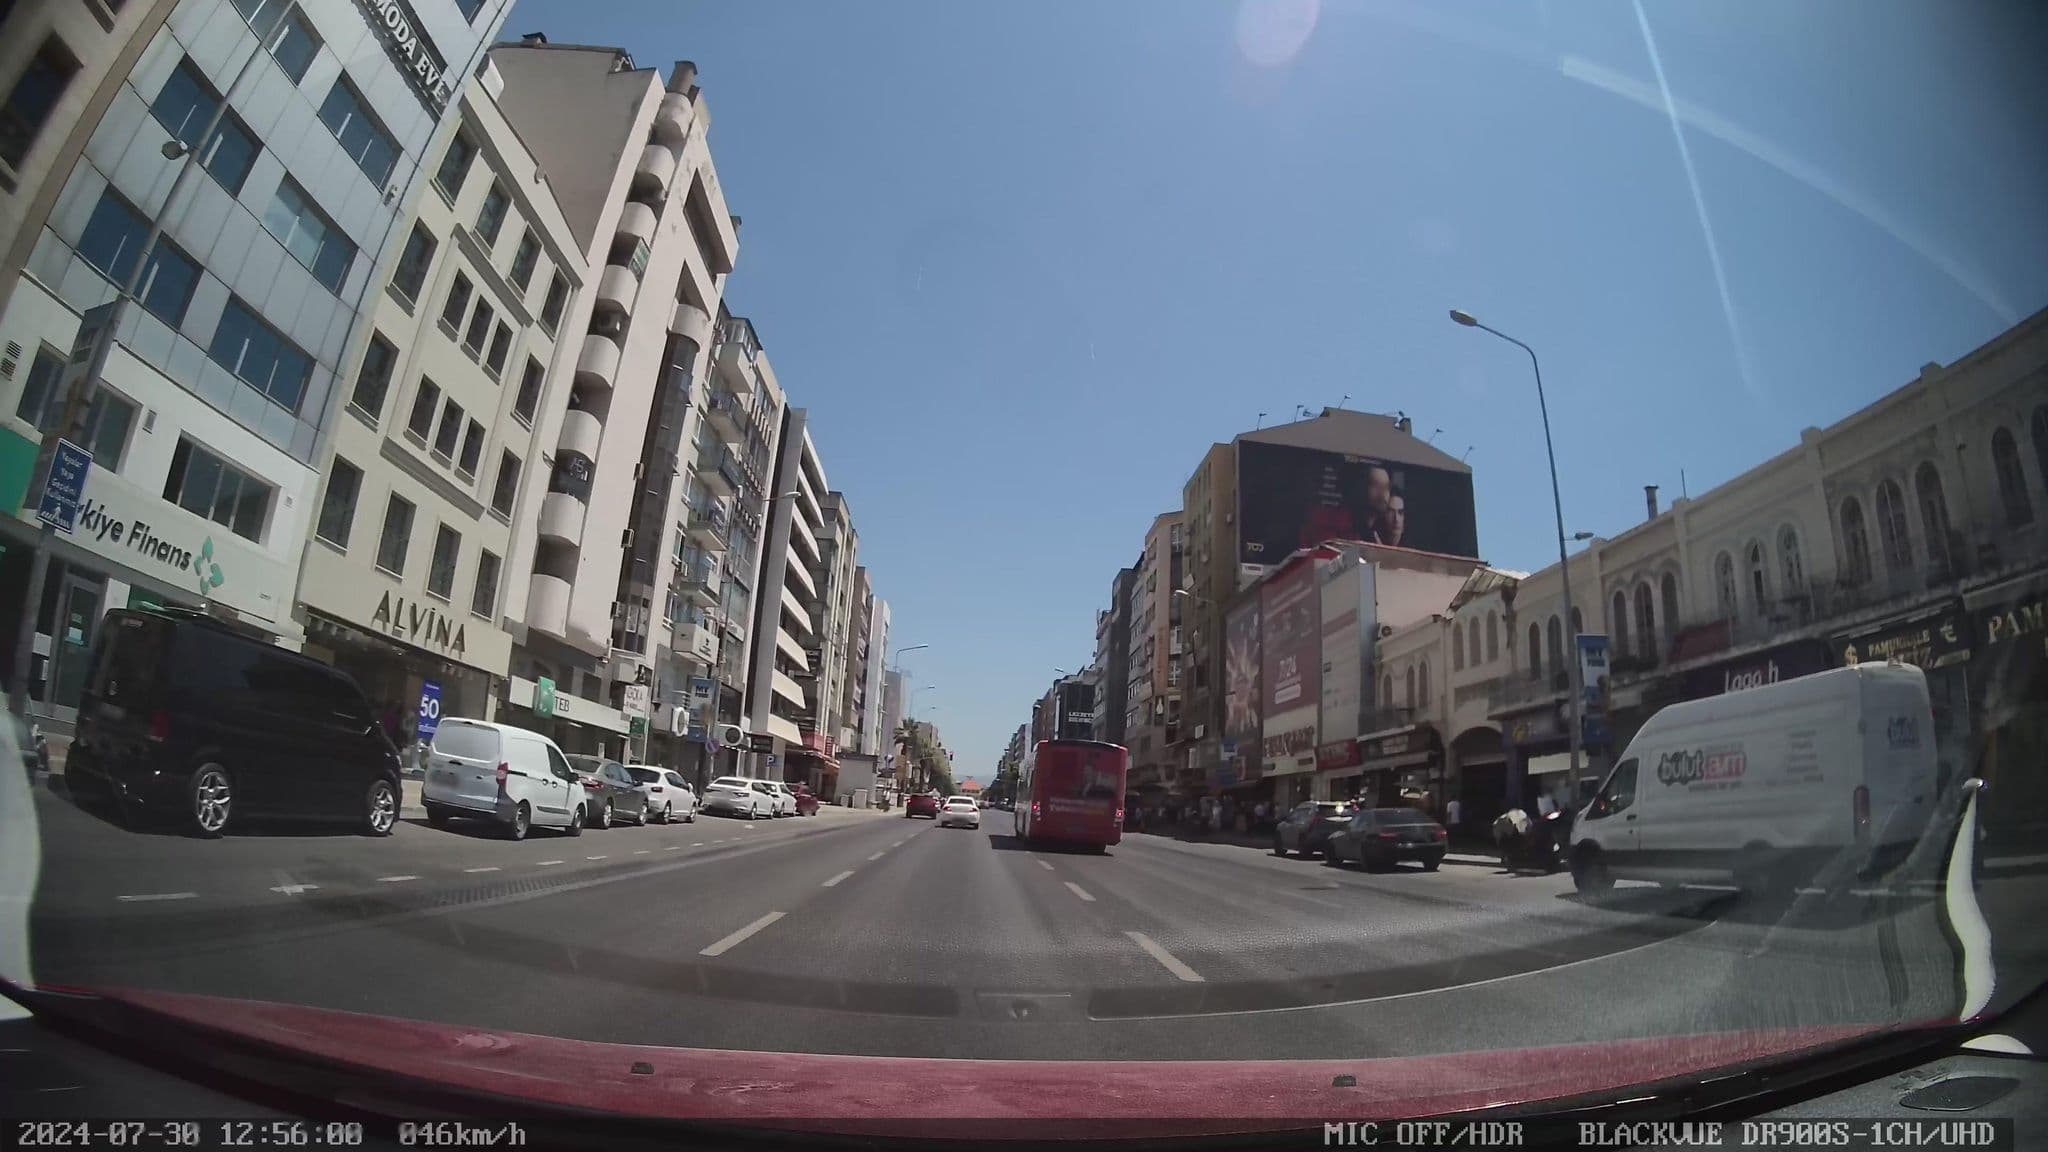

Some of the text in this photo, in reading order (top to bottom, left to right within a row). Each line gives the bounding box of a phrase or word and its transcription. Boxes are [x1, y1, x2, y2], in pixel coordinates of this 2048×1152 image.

[127, 520, 192, 571] Finans
[371, 590, 466, 653] ALVİNA
[419, 695, 440, 719] 50
[555, 696, 569, 712] TEB
[766, 755, 775, 766] P
